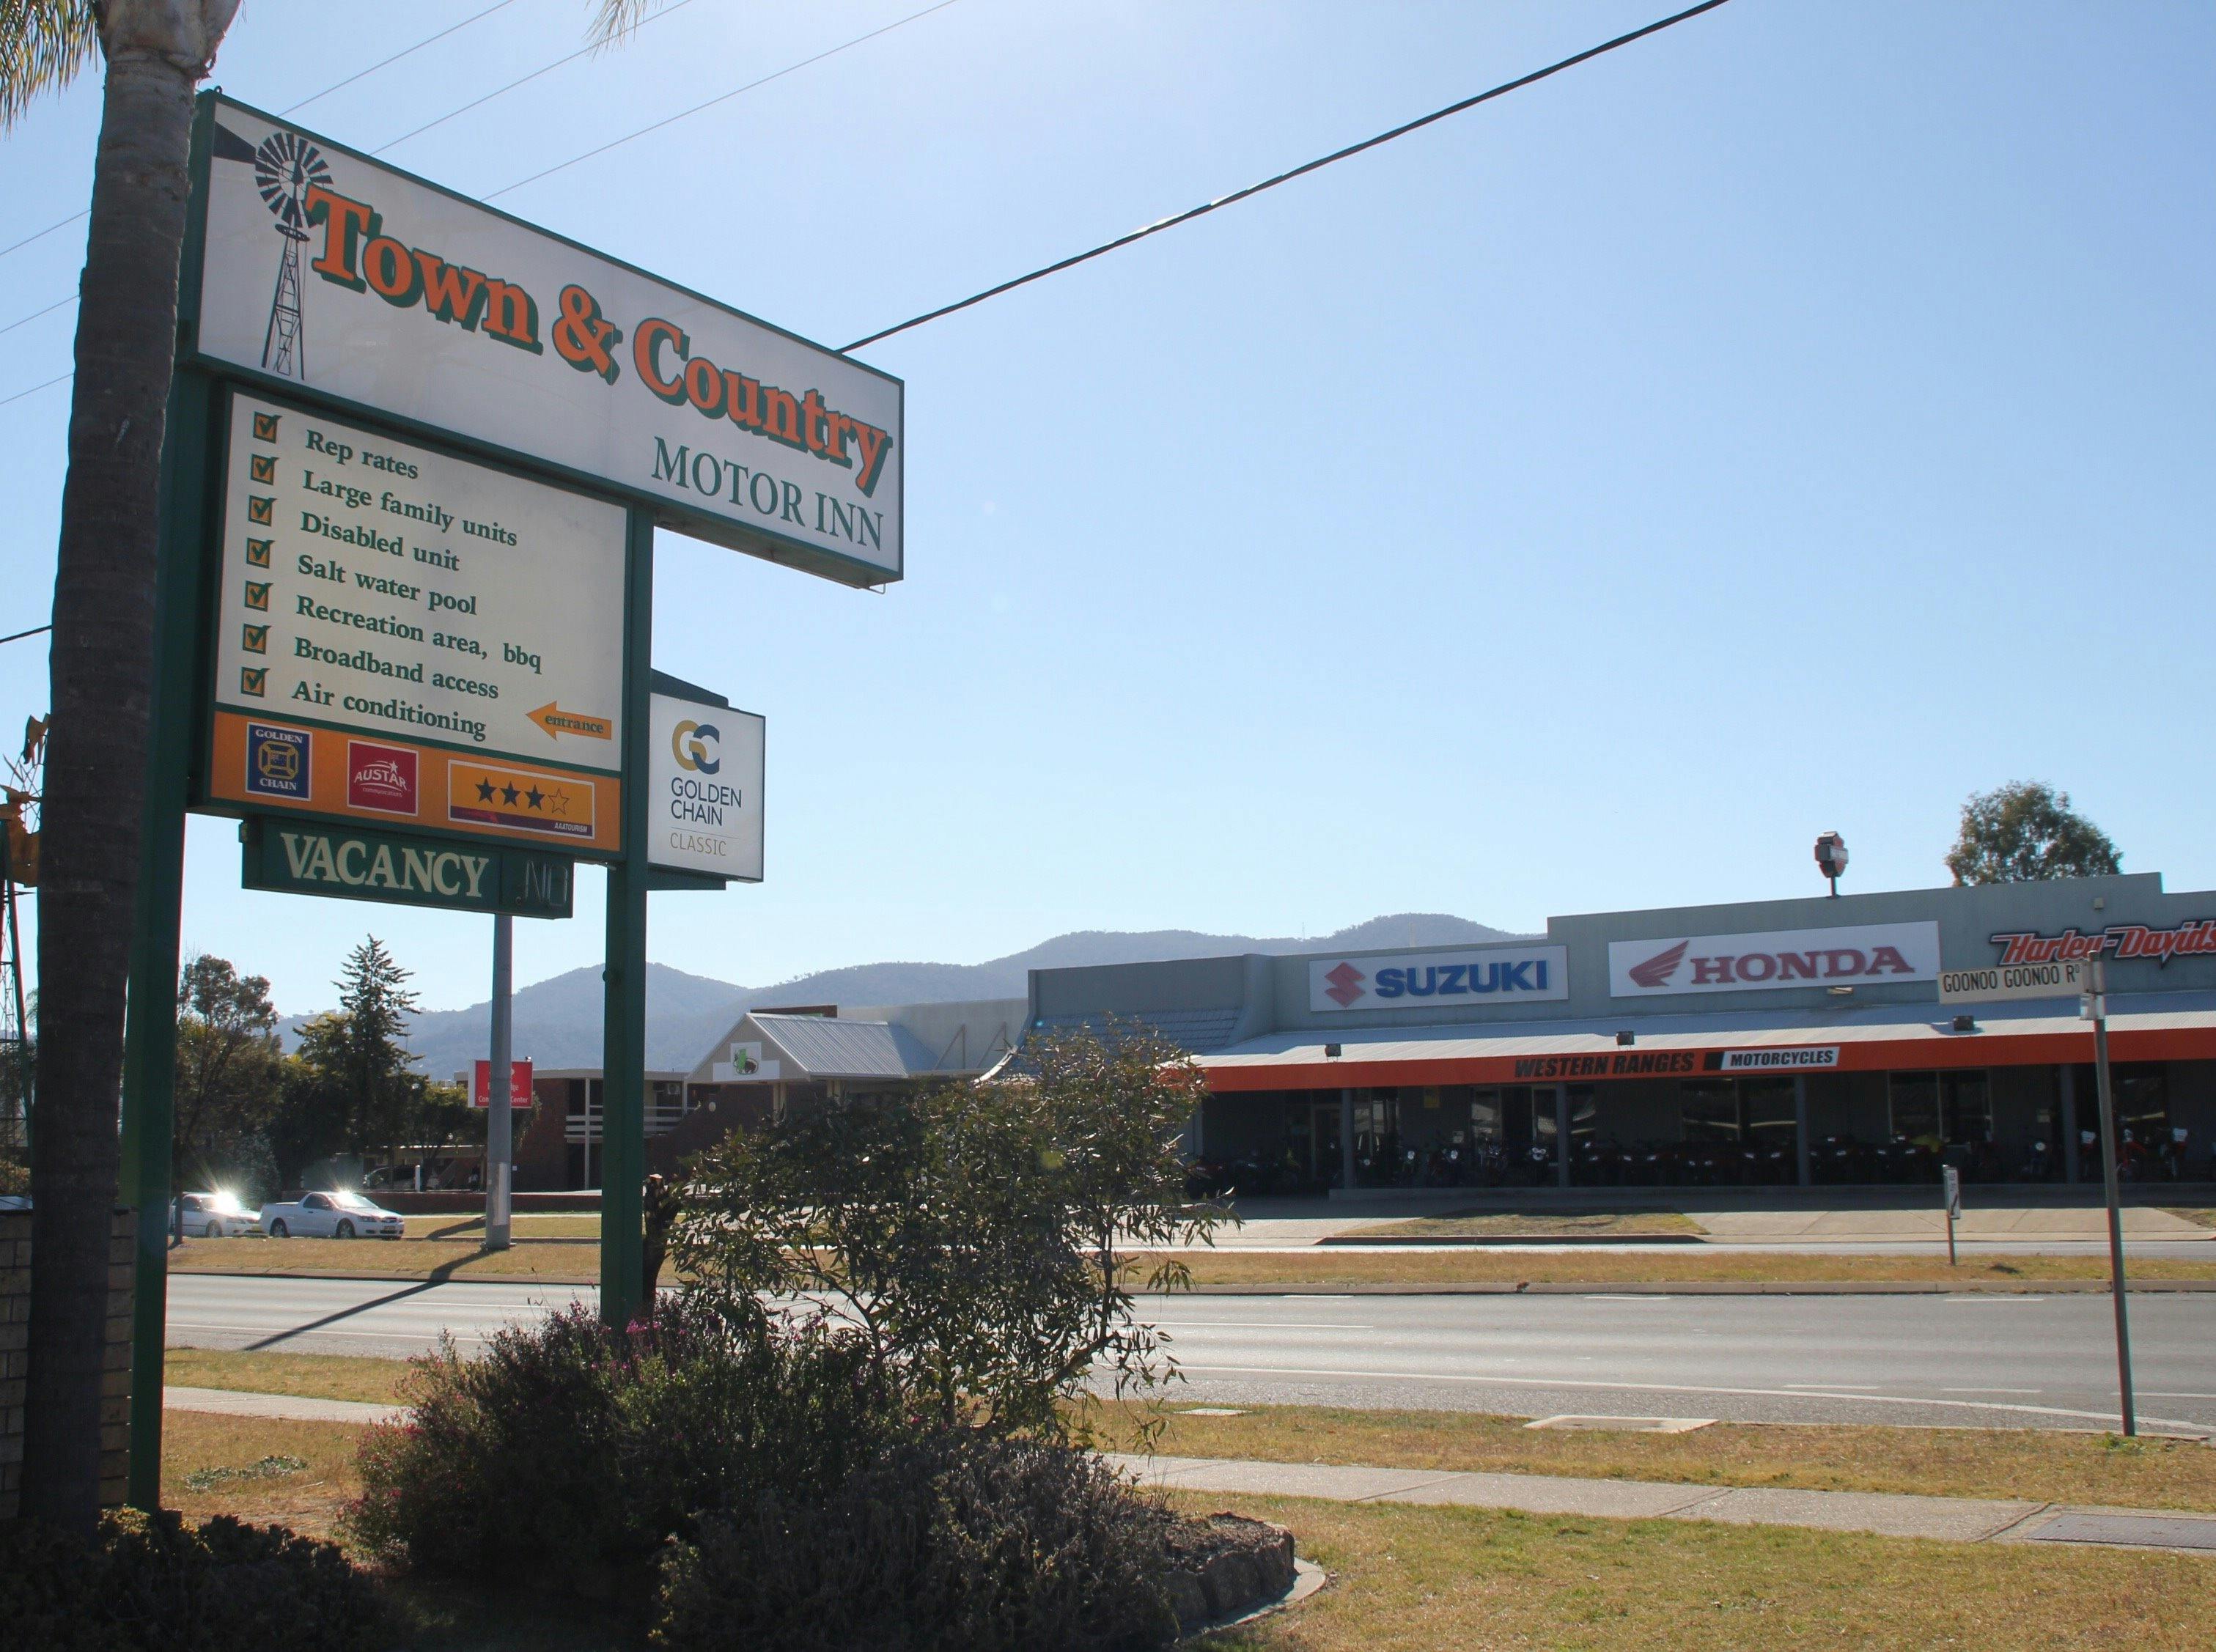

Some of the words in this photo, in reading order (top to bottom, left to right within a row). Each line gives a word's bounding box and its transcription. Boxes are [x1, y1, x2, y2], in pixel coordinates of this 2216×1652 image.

[305, 183, 543, 355] Town
[551, 283, 622, 385] &
[632, 316, 894, 497] Country
[306, 429, 353, 465] Rep
[361, 451, 419, 479] rates
[303, 470, 372, 508] Large
[380, 492, 454, 534] family
[463, 517, 518, 546] units
[651, 436, 804, 527] MOTOR
[815, 495, 884, 551] INN
[301, 512, 404, 557] Disabled
[413, 544, 460, 572] unit
[298, 554, 347, 583] Salt
[356, 569, 420, 601] water
[427, 587, 477, 616] pool
[296, 594, 424, 642] Recreation
[433, 633, 488, 660] area,
[504, 643, 542, 675] bbq
[295, 637, 424, 684] Broadband
[432, 673, 498, 699] access
[292, 681, 335, 706] Air
[343, 693, 487, 742] conditioning
[545, 712, 604, 734] entrance
[255, 729, 303, 744] GOLDEN
[259, 778, 297, 791] CHAIN
[353, 769, 407, 791] AUSTAR
[671, 777, 742, 808] GOLDEN
[554, 822, 588, 833] AAATOURISM
[671, 799, 723, 827] CHAIN
[670, 832, 726, 856] CLASSIC
[280, 831, 490, 899] VACANCY
[1375, 960, 1548, 999] SUZUKI
[1690, 946, 1915, 985] HONDA
[1943, 970, 1998, 993] GOONOO
[2004, 965, 2059, 989] GOONOO
[1514, 1055, 1609, 1078] WESTERN
[1613, 1052, 1694, 1074] RANGES
[1730, 1050, 1833, 1066] MOTORCYCLES
